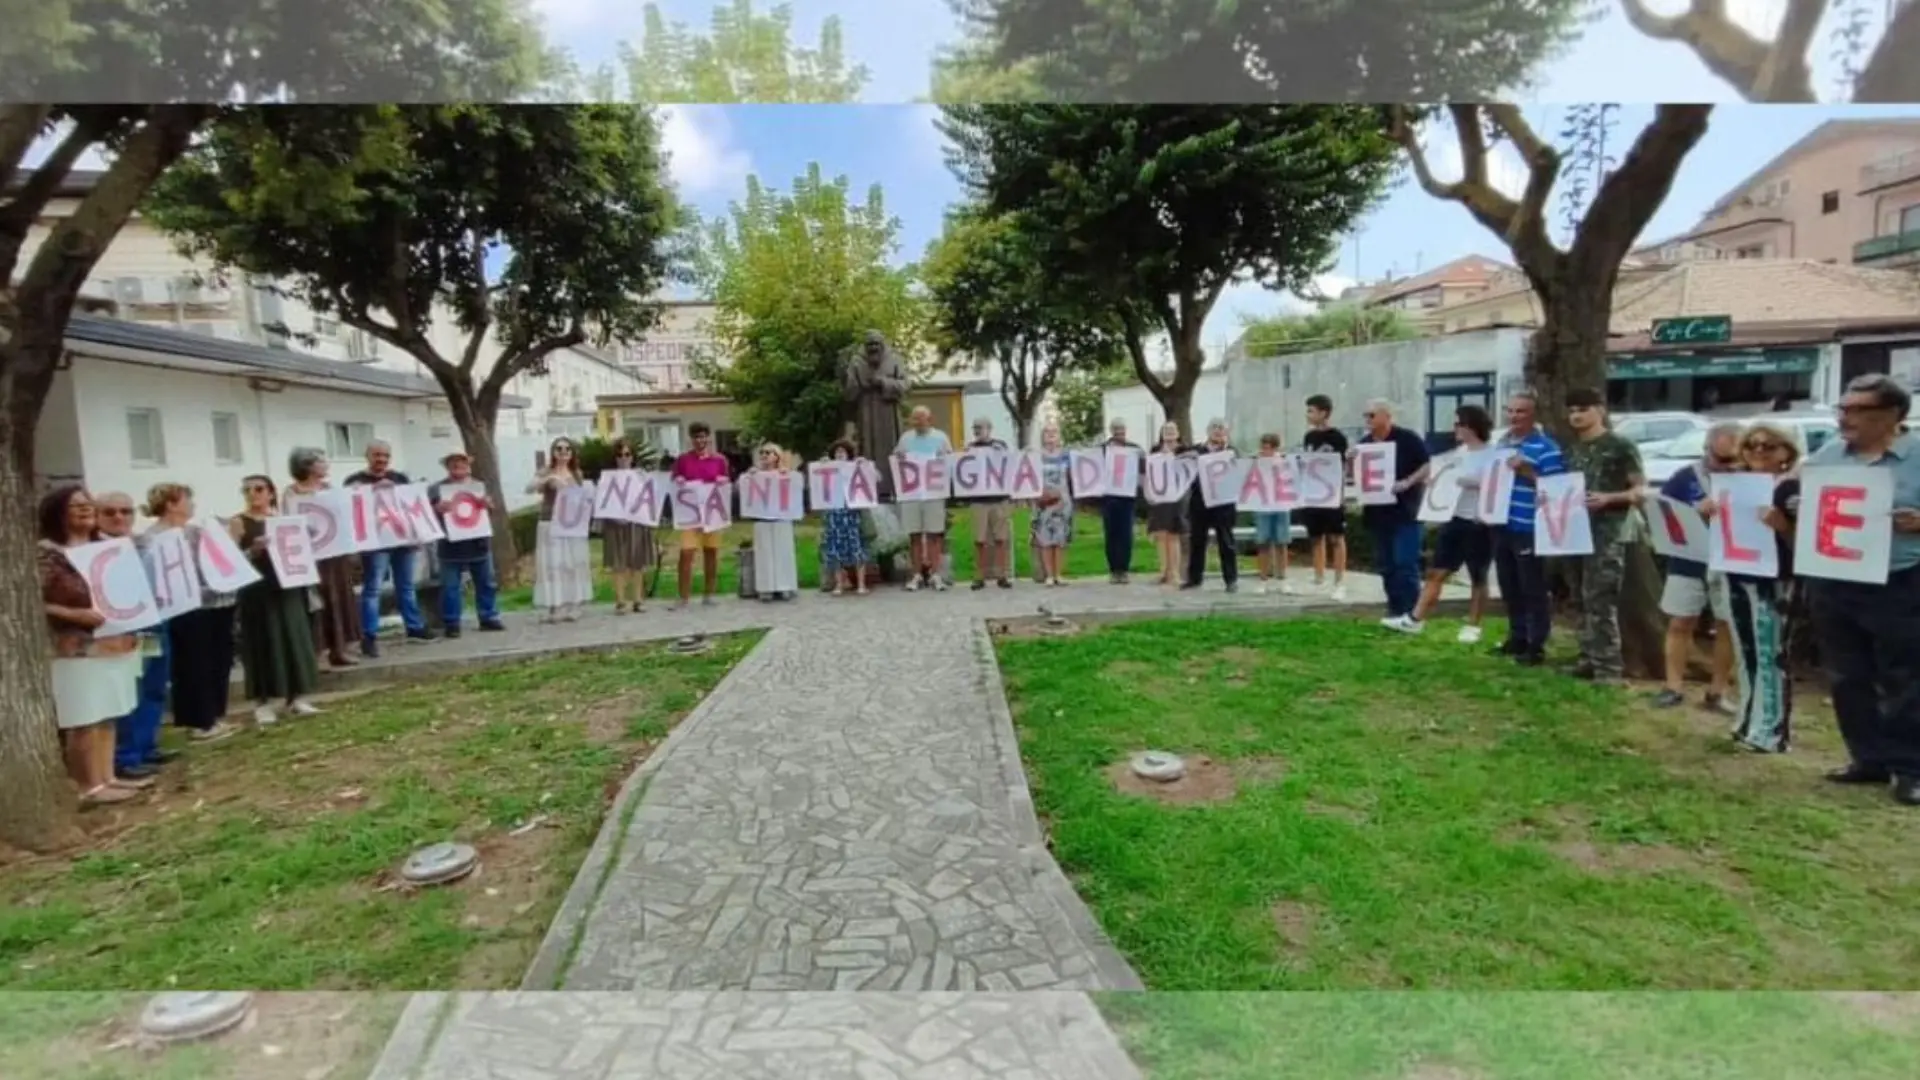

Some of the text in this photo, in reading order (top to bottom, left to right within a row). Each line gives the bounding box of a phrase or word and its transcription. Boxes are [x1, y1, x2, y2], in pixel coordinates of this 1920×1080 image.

[89, 484, 485, 620] CHIEDIAMO
[557, 475, 657, 529] UNA
[901, 453, 1041, 492] DEGNA
[1077, 452, 1127, 495] DI
[1431, 455, 1867, 562] CIVILE
